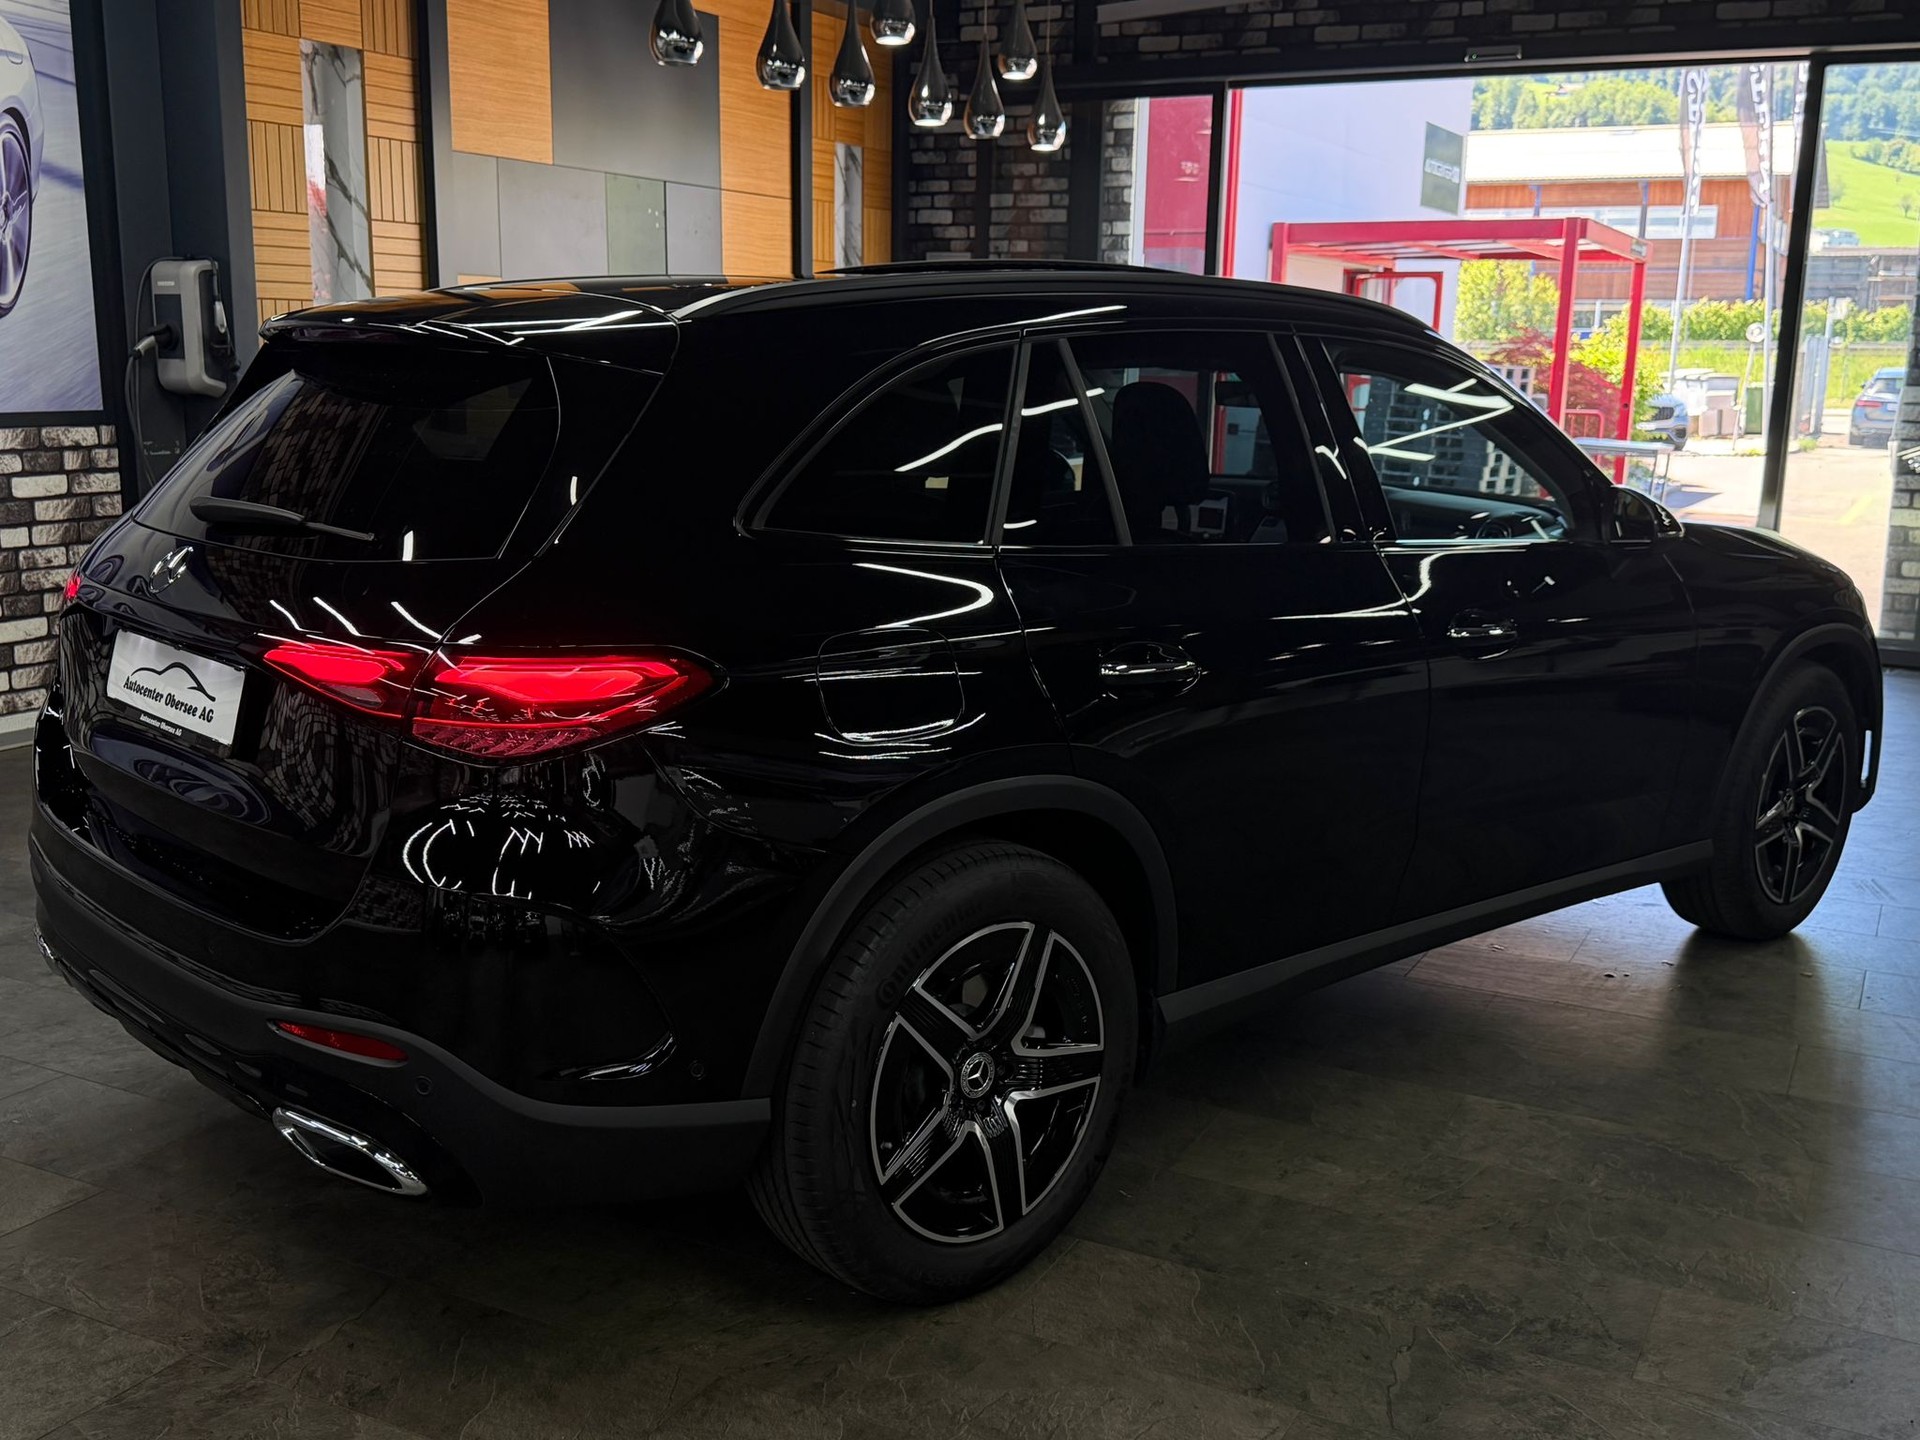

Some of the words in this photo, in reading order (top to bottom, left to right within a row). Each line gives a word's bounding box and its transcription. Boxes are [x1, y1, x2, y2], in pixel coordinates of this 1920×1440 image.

[124, 676, 164, 703] Autocenter
[164, 692, 198, 717] Obersee
[200, 706, 214, 723] AG
